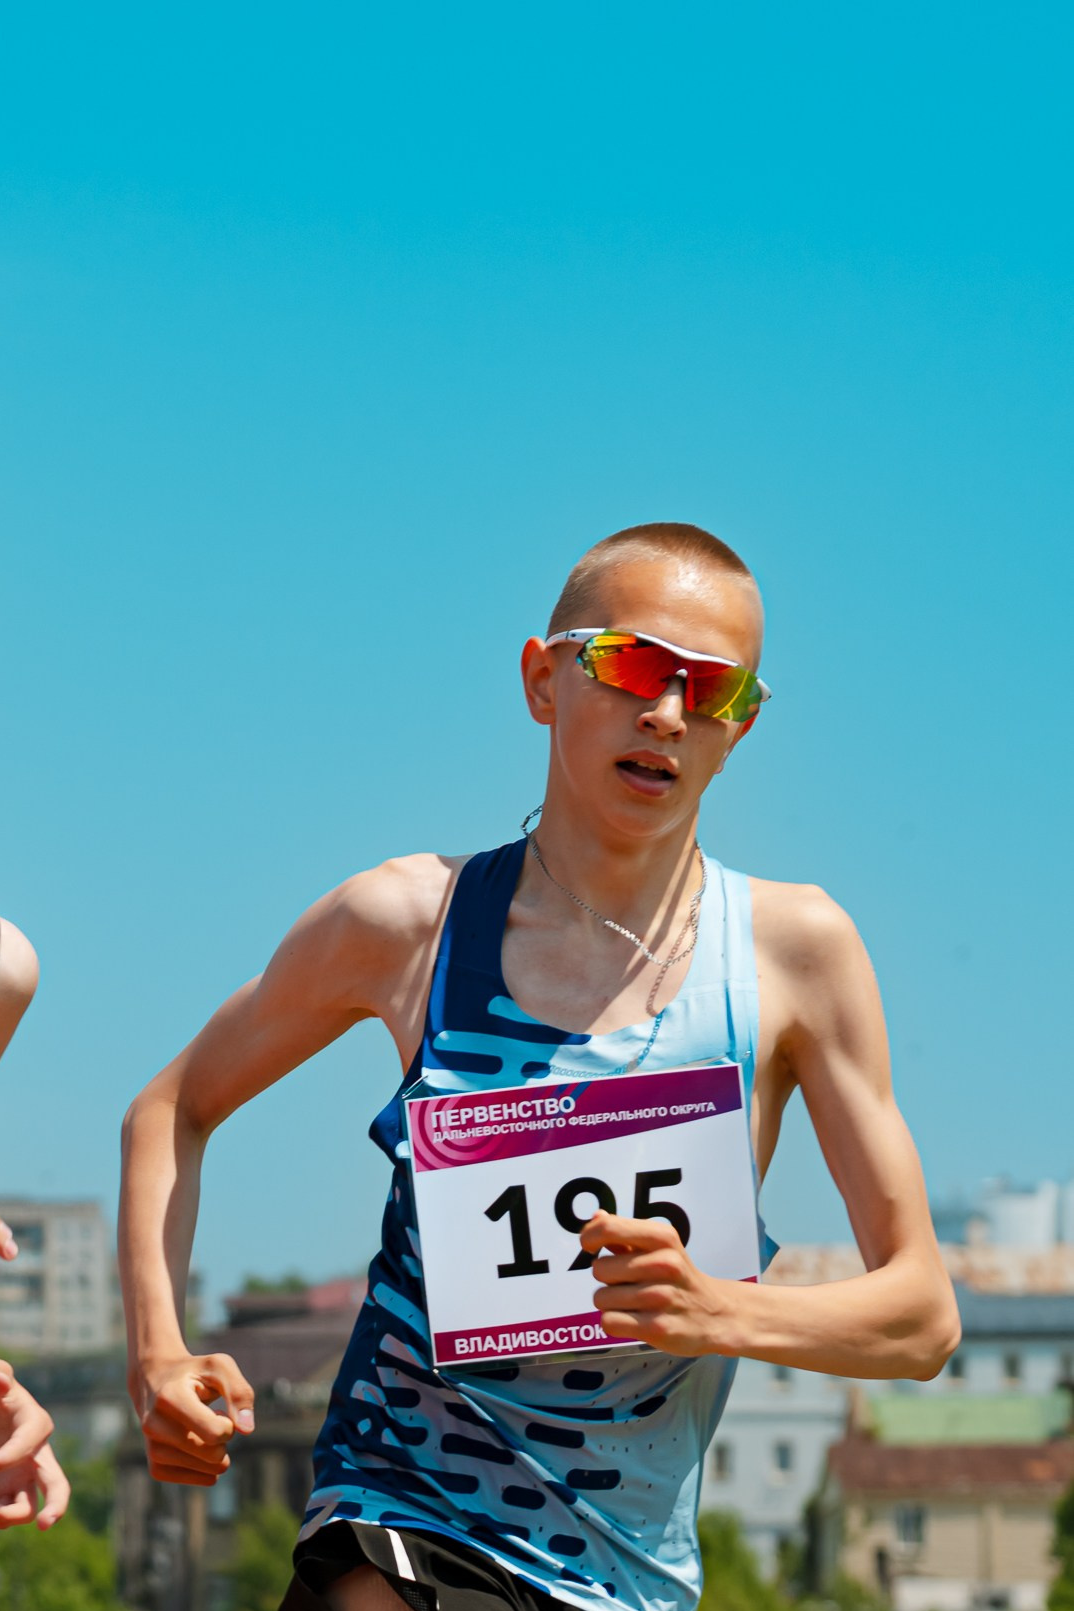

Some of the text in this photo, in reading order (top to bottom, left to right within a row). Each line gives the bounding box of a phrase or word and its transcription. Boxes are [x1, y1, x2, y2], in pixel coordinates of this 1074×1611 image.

[431, 1096, 576, 1129] ПЕРВЕНСТВО
[433, 1102, 716, 1143] ДАЛЬНЕВОСТОЧНОГО ФЕДЕРАЛЬНОГО ОКРУГА
[483, 1167, 691, 1279] 195
[454, 1324, 608, 1355] ВЛАДИВОСТОК
